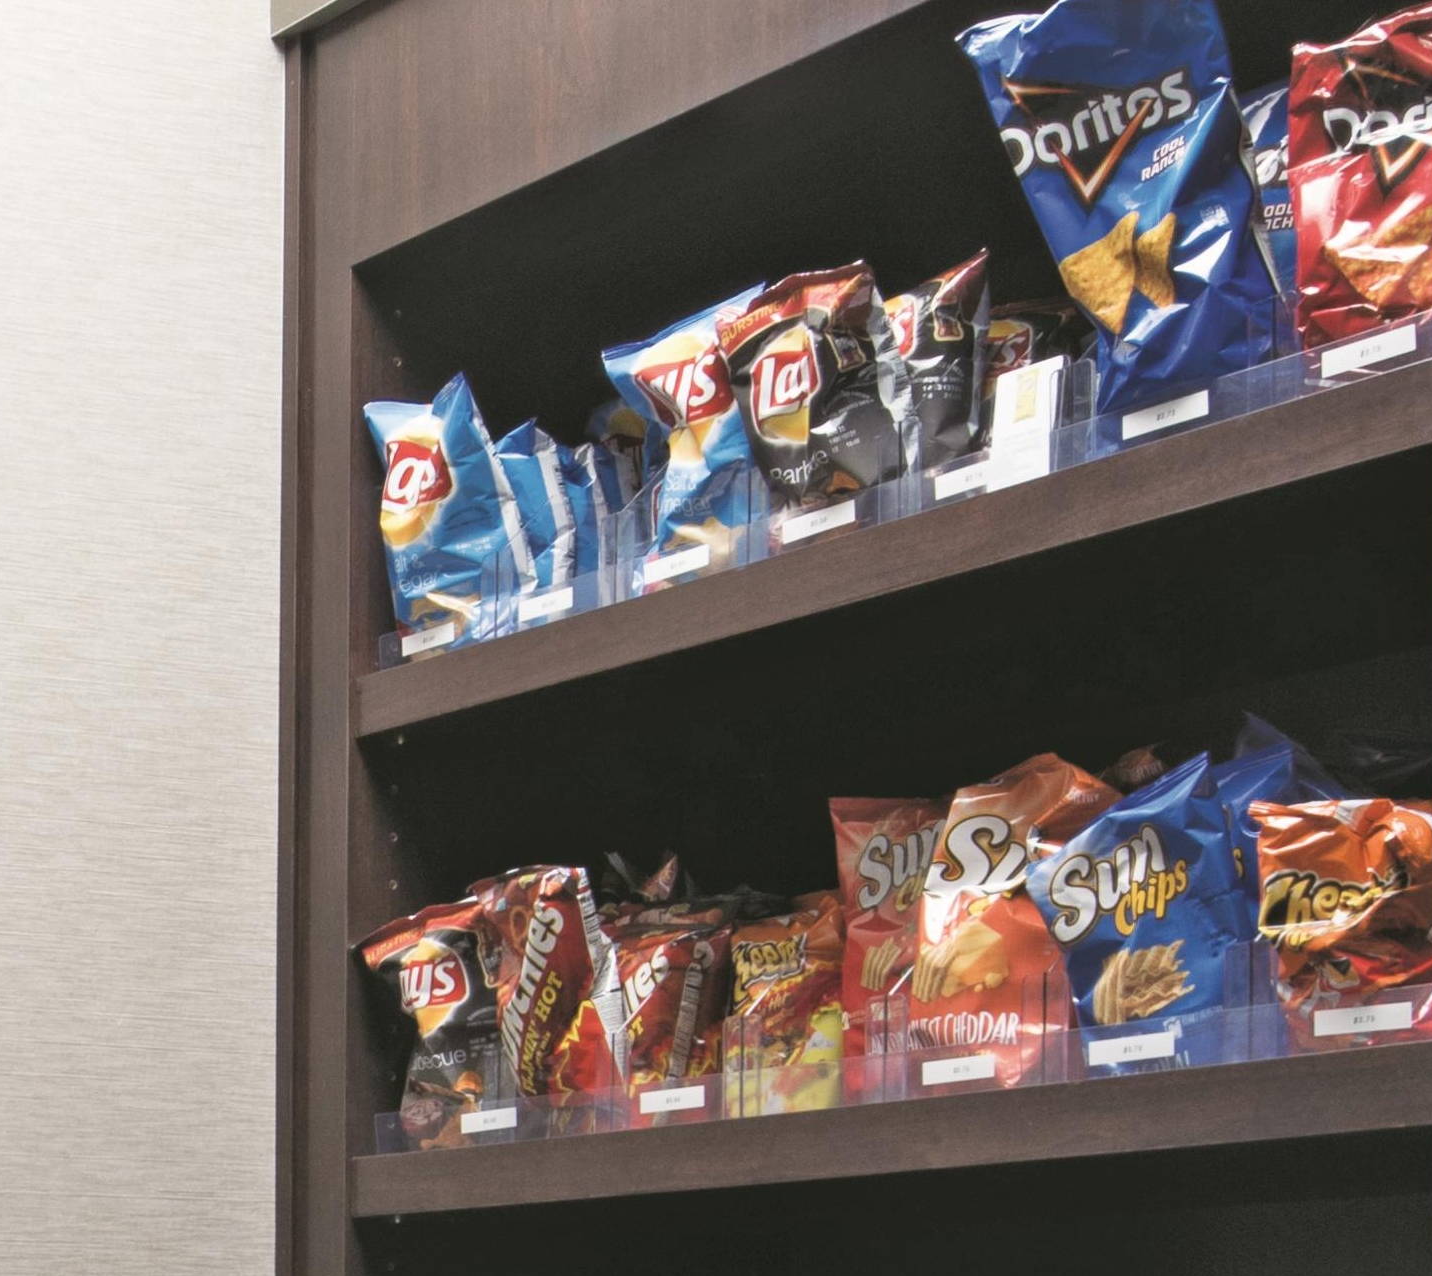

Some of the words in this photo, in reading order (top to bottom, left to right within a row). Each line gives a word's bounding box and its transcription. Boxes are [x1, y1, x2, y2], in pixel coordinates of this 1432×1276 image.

[1152, 135, 1186, 160] COOL
[1049, 823, 1168, 946] Sun
[535, 970, 564, 1023] HOT
[943, 1011, 1020, 1046] CHEDDAR
